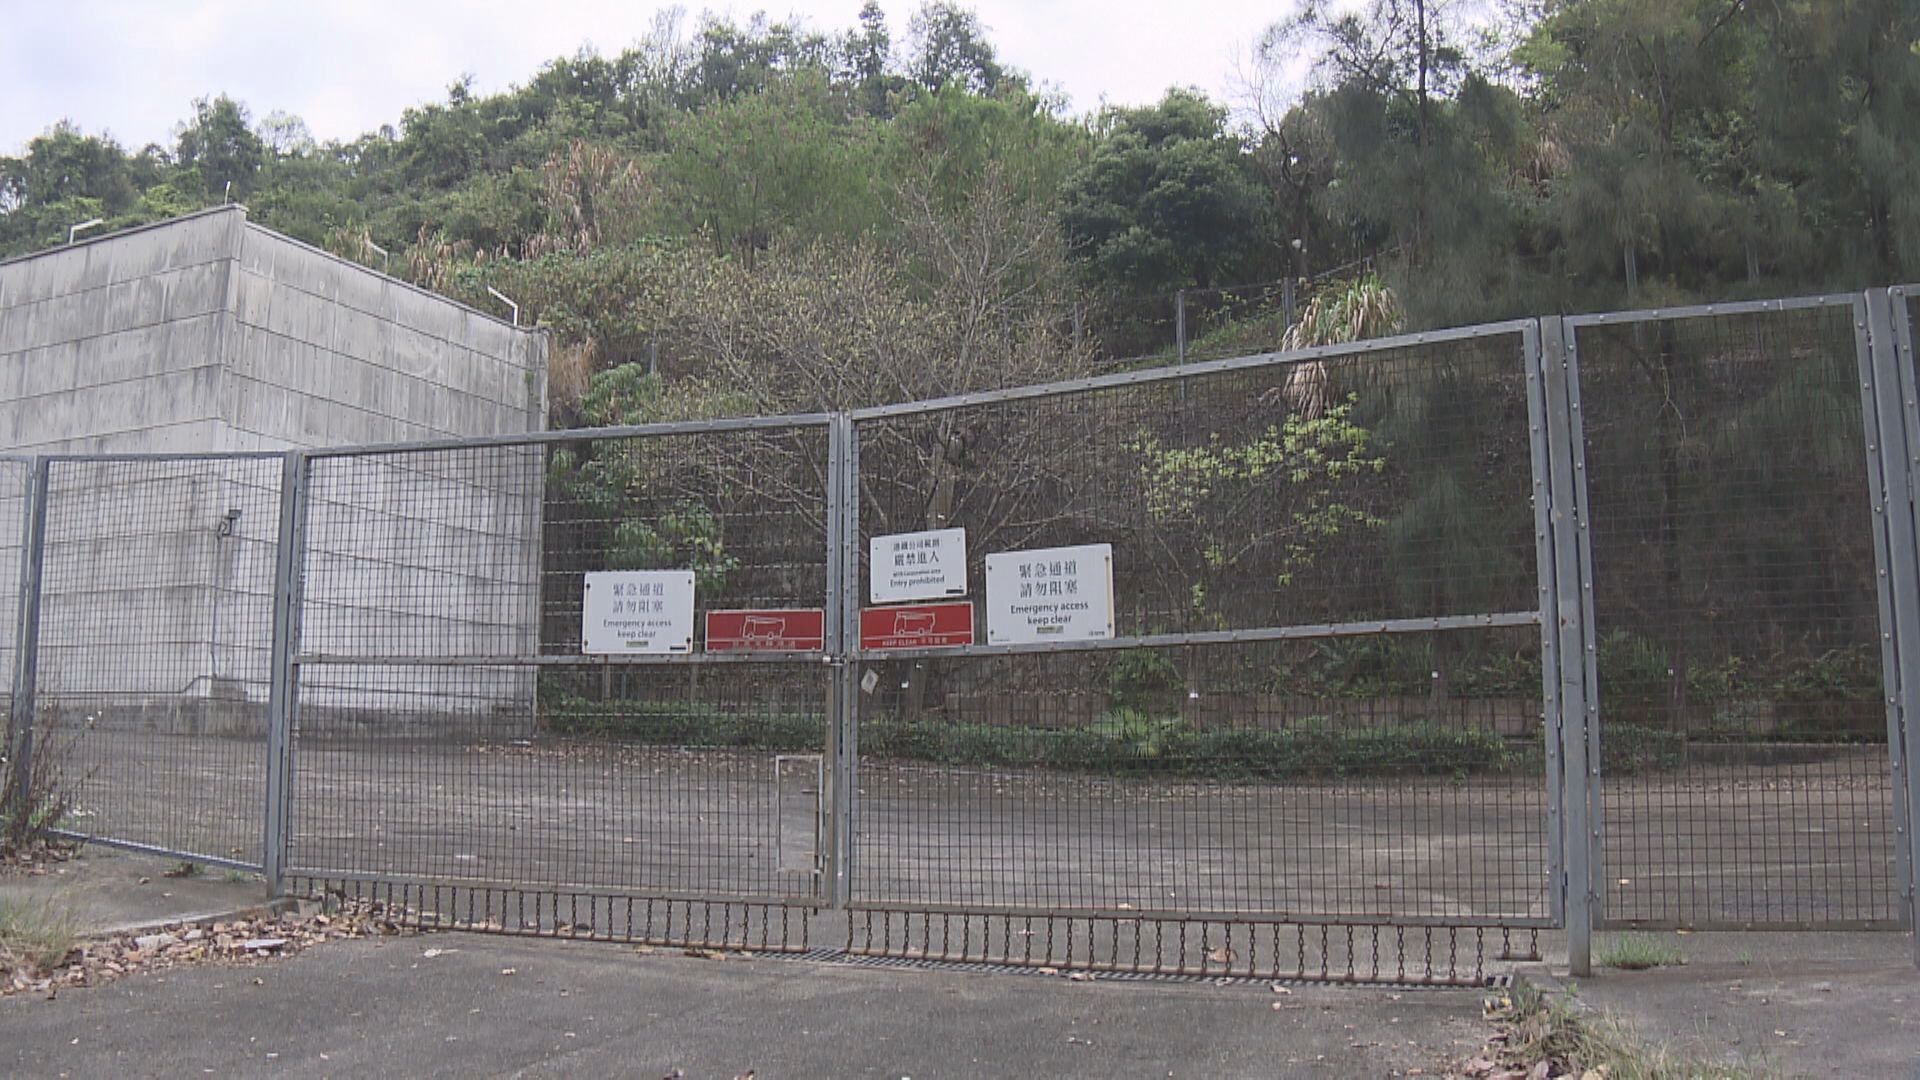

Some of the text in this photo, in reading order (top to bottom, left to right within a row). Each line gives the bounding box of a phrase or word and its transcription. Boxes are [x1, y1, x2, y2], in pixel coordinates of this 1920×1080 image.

[894, 550, 940, 566] 嚴禁進入
[1019, 559, 1077, 579] 緊急通道
[890, 575, 945, 588] Entry prohibited
[1020, 579, 1077, 598] 請勿阻塞
[613, 582, 664, 597] 緊急通道
[612, 599, 664, 614] 請勿阻塞
[1010, 601, 1089, 615] Emergency access
[603, 619, 672, 630] Emergency access
[1027, 615, 1072, 626] keep clear
[617, 629, 656, 640] keep clear
